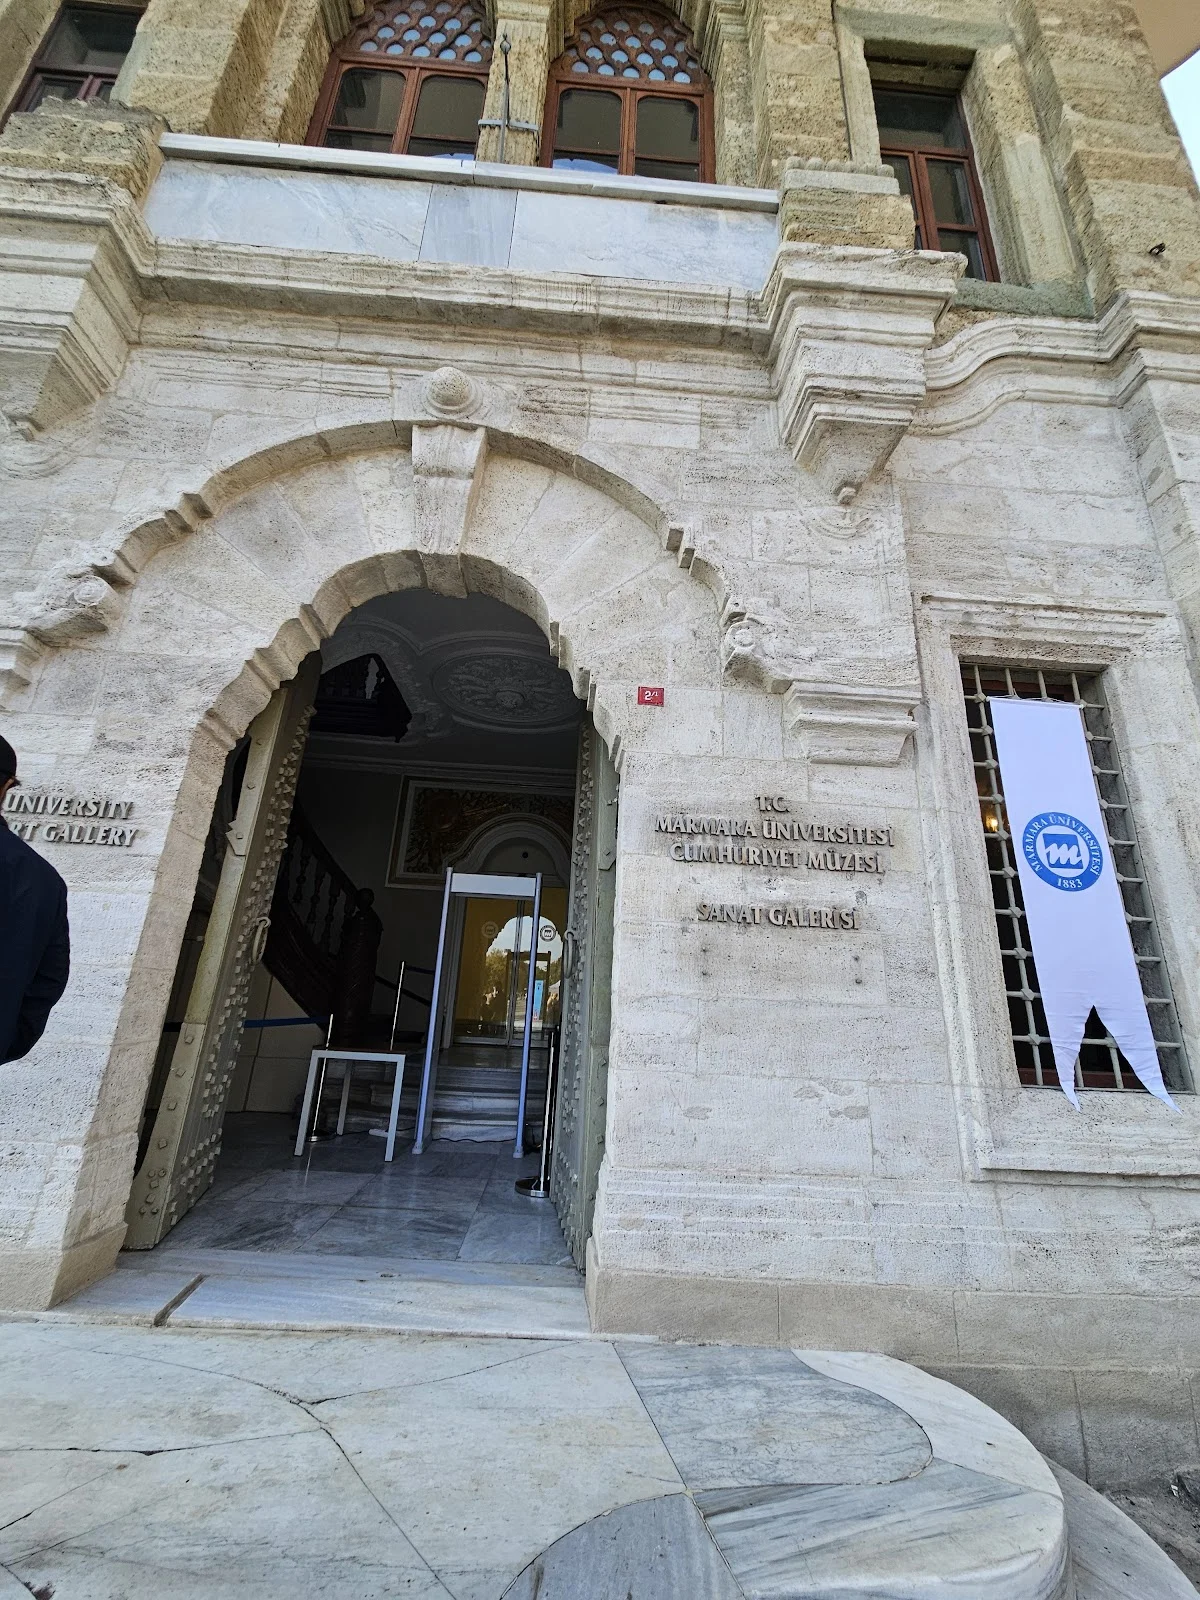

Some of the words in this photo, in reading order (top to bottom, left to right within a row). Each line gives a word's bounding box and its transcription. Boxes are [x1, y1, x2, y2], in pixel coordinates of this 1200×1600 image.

[3, 793, 134, 820] UNIVERSITY
[756, 795, 790, 813] T.C.
[8, 821, 38, 842] RT
[43, 823, 138, 847] GALLERY
[655, 814, 757, 838] MARMARA
[762, 818, 895, 847] ÜNİVERSİTESİ
[1025, 818, 1048, 872] MARMARA
[1048, 813, 1101, 876] ÜNİVERSİTESİ
[669, 840, 800, 868] CUMHURİYET
[807, 848, 884, 874] MÜZESİ
[1057, 878, 1083, 889] 1883
[697, 900, 762, 925] SANAT
[768, 906, 862, 930] GALERİSİ
